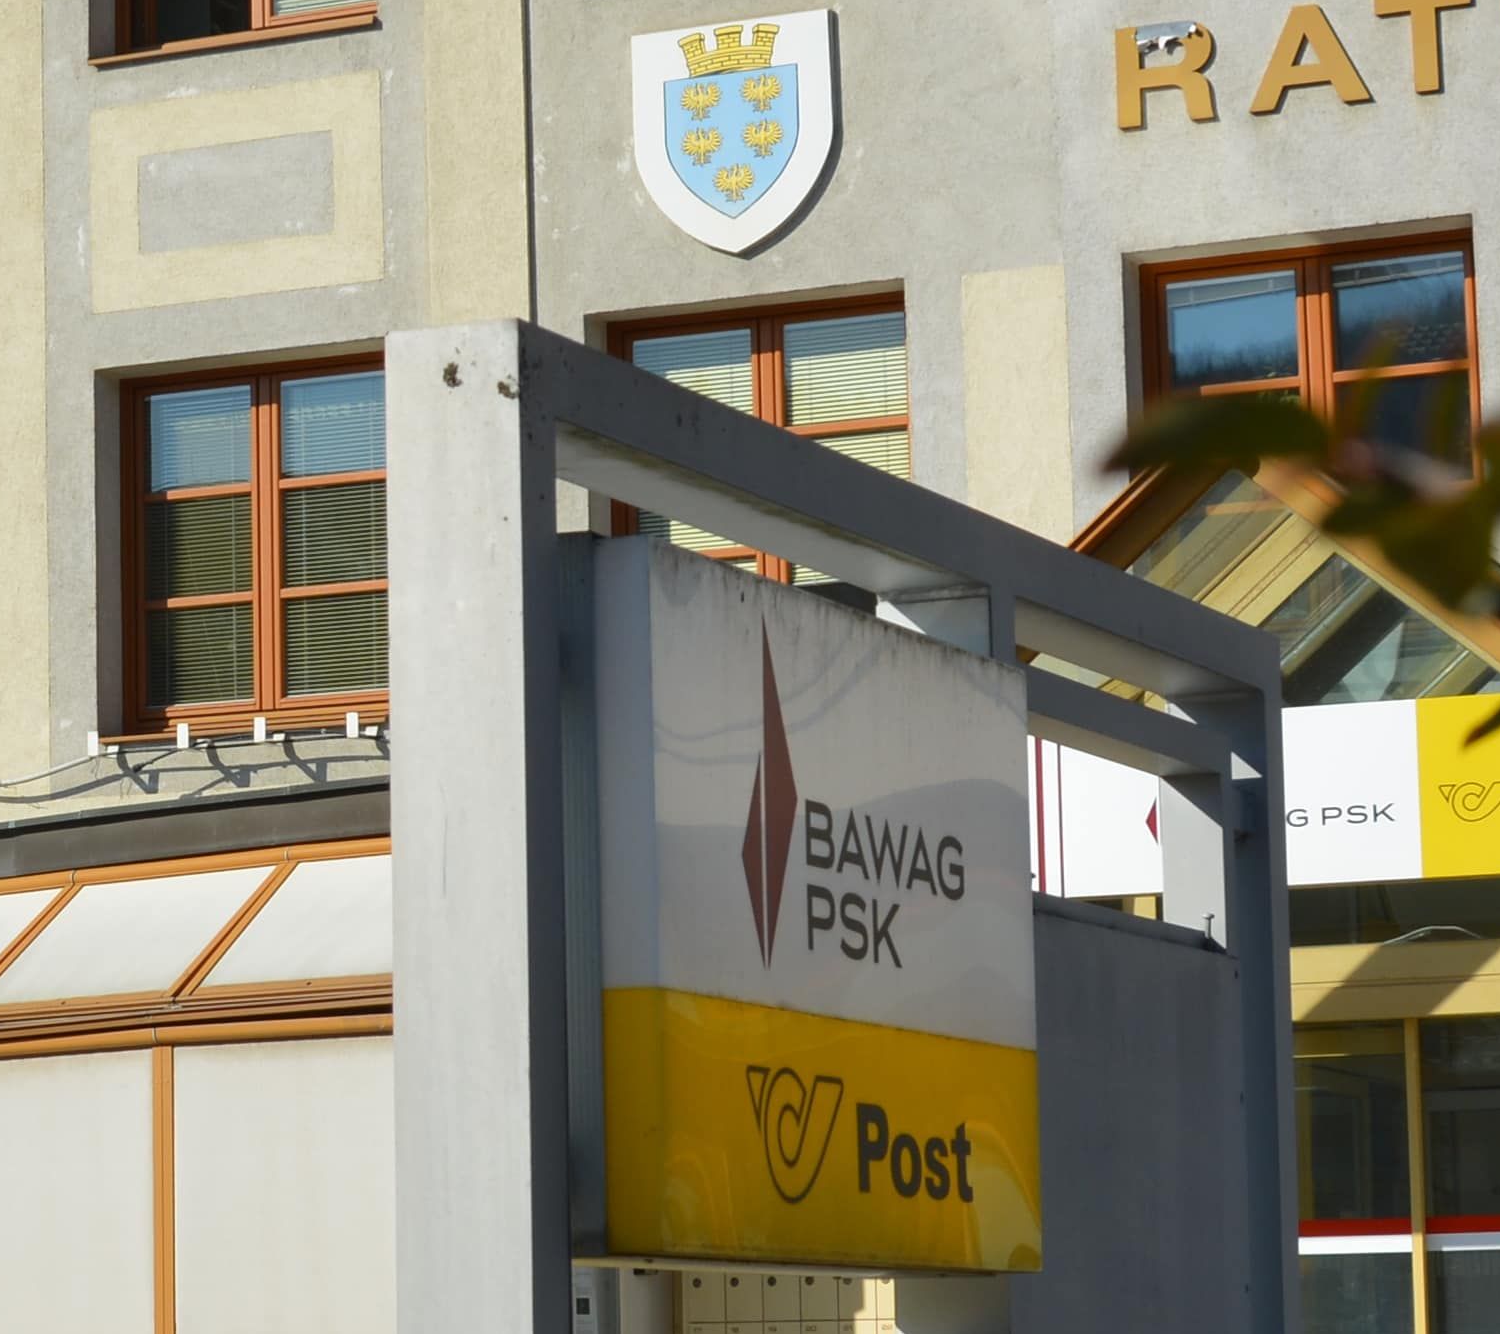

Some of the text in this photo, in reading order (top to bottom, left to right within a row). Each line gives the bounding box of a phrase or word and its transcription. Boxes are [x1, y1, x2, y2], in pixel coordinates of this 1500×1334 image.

[804, 798, 966, 901] BAWAG
[1322, 803, 1395, 826] PSK
[806, 883, 902, 967] PSK
[855, 1103, 974, 1203] Post
